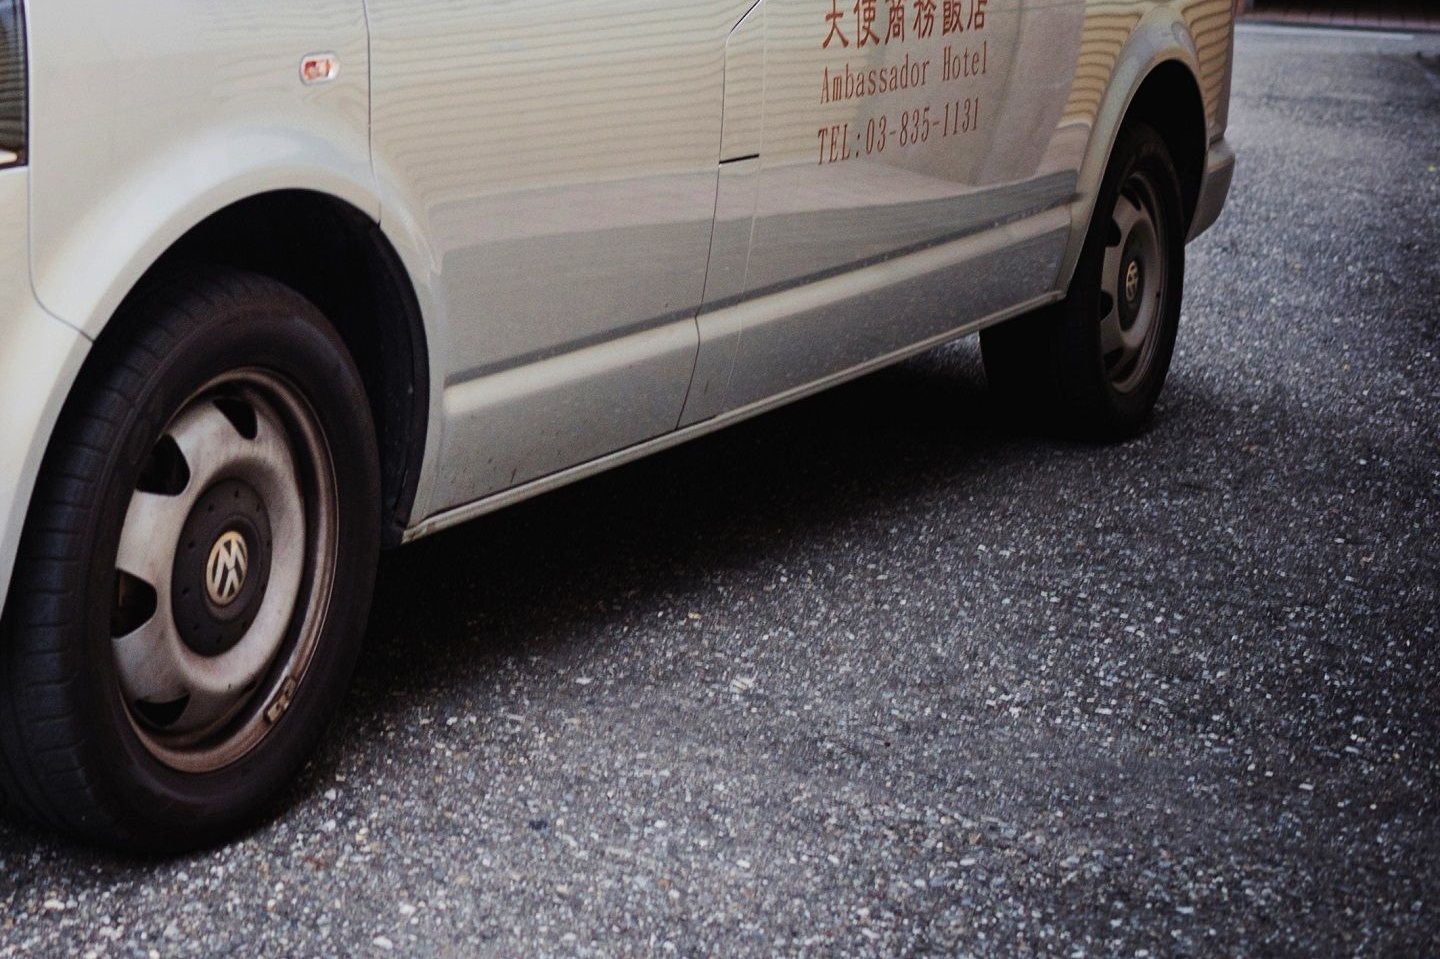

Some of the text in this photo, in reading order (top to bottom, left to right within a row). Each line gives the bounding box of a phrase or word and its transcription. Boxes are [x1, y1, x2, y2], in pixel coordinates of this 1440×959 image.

[820, 40, 988, 104] Ambassador Hotel
[817, 97, 980, 165] TEL:03-835-1131
